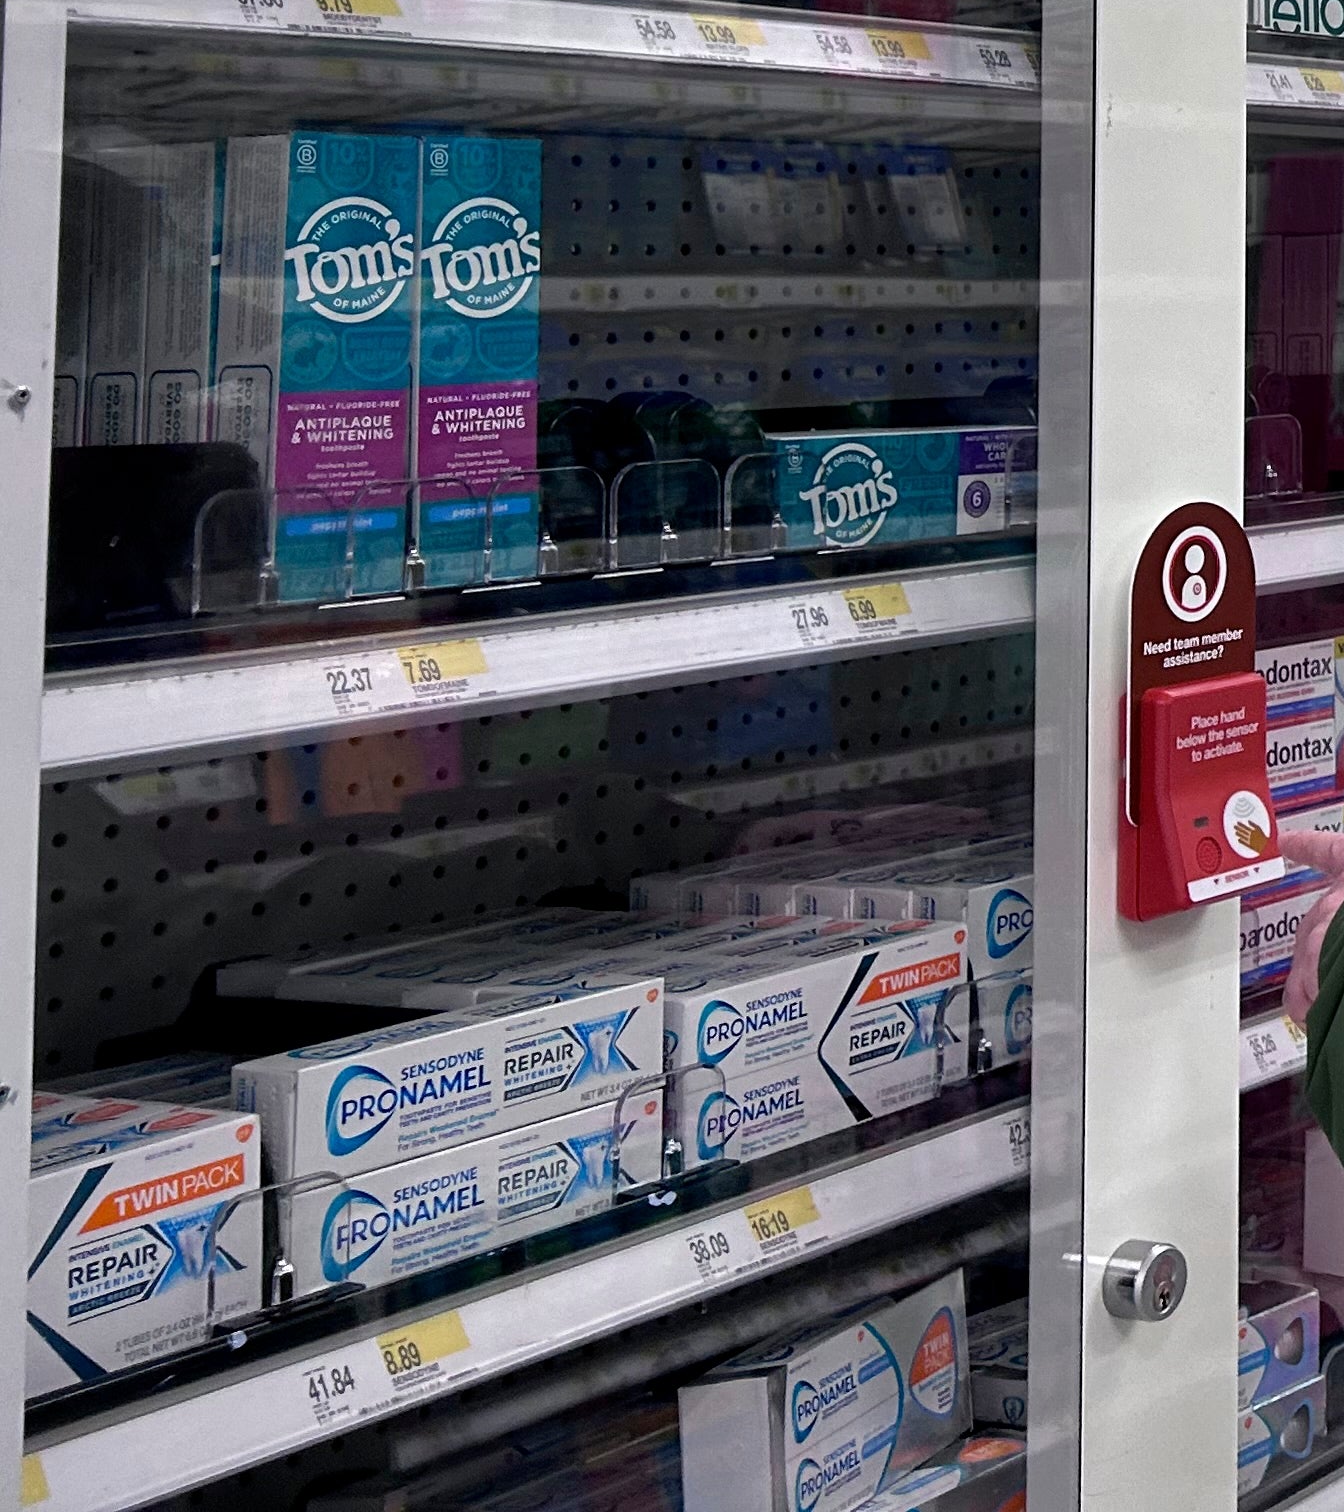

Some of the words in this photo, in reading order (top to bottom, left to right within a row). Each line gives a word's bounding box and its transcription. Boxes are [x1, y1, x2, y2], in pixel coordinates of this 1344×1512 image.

[634, 17, 676, 42] 54.58
[698, 22, 737, 45] 13.99
[815, 33, 852, 55] 54.58
[870, 37, 905, 58] 13.99
[312, 222, 330, 242] THE
[331, 209, 382, 230] ORIGINAL
[446, 221, 463, 242] THE
[463, 209, 510, 228] ORIGINAL
[285, 219, 413, 301] Tom's
[421, 217, 540, 299] Tom's
[333, 298, 349, 309] OF
[352, 287, 386, 309] MAINE
[467, 294, 482, 305] OF
[484, 283, 515, 304] MAINE
[427, 395, 463, 404] NATURAL
[471, 390, 531, 402] FLUORIDE-FREE
[295, 415, 392, 431] ANTIPLAQUE
[431, 423, 440, 435] &
[446, 418, 526, 434] WHITENING
[434, 406, 524, 421] ANTIPLAQUE
[291, 432, 301, 444] &
[307, 428, 394, 444] WHITENING
[320, 444, 365, 453] toothpaste
[458, 434, 499, 443] toothpaste
[834, 454, 871, 470] ORIGINAL
[799, 459, 898, 535] Tom's
[973, 492, 982, 506] 6
[792, 606, 829, 630] 27.96
[849, 600, 876, 622] 6.99
[1143, 640, 1172, 656] Need
[1173, 637, 1200, 651] team
[1201, 629, 1244, 646] member
[1163, 645, 1224, 668] assistance?
[326, 668, 373, 695] 22.37
[403, 658, 441, 684] 7.69
[1191, 714, 1218, 730] Place
[1220, 706, 1245, 723] hand
[1176, 733, 1206, 750] below
[1208, 727, 1224, 742] the
[1226, 722, 1259, 738] sensor
[1191, 749, 1202, 762] to
[1203, 740, 1244, 761] activate.
[880, 969, 919, 994] TWIN
[921, 958, 957, 982] PACK
[746, 988, 803, 1013] SENSODYNE
[707, 1001, 808, 1045] PRONAMEL
[850, 1021, 906, 1051] REPAIR
[400, 1048, 484, 1081] SENSODYNE
[504, 1043, 574, 1076] REPAIR
[504, 1064, 563, 1087] WHITENING
[341, 1065, 492, 1124] PRONAMEL
[581, 1091, 597, 1102] NET
[744, 1076, 800, 1102] SENSODYNE
[114, 1179, 178, 1216] TWIN
[181, 1160, 239, 1195] PACK
[393, 1166, 478, 1203] SENSODYNE
[498, 1158, 568, 1195] REPAIR
[498, 1181, 557, 1205] WHITENING
[336, 1184, 485, 1250] PRONAMEL
[752, 1210, 789, 1241] 16.19
[690, 1232, 730, 1263] 38.09
[69, 1243, 158, 1288] REPAIR
[69, 1270, 145, 1301] WHITENING
[383, 1342, 421, 1375] 8.89
[309, 1365, 355, 1402] 41.84
[797, 1375, 857, 1422] PRONAMEL
[801, 1449, 860, 1500] PRONAMEL
